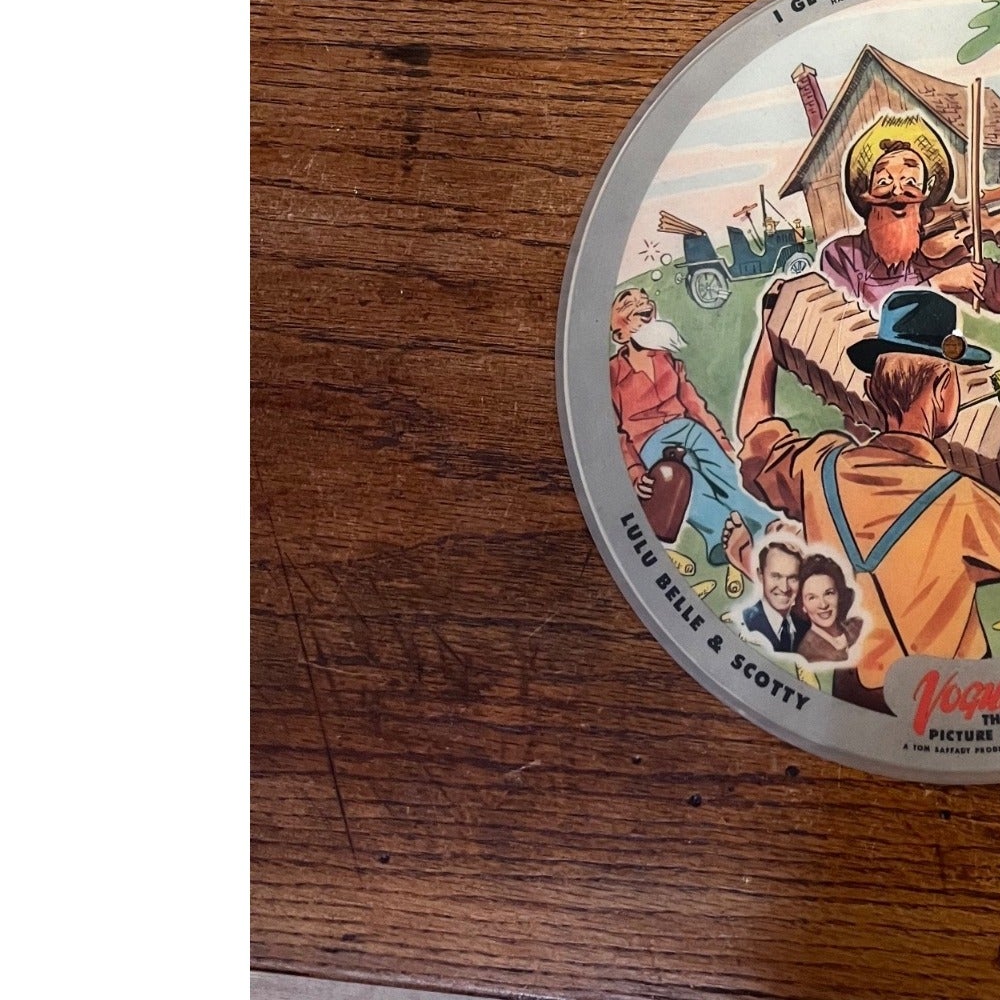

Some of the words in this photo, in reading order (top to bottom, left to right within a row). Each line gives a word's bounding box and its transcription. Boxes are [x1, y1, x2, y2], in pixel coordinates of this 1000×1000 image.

[772, 9, 784, 23] I
[620, 512, 658, 568] LULU
[655, 572, 705, 632] BELLE
[707, 634, 724, 654] &
[730, 653, 811, 711] SCOTTY
[929, 728, 994, 742] PICTURE
[913, 744, 930, 752] TOM
